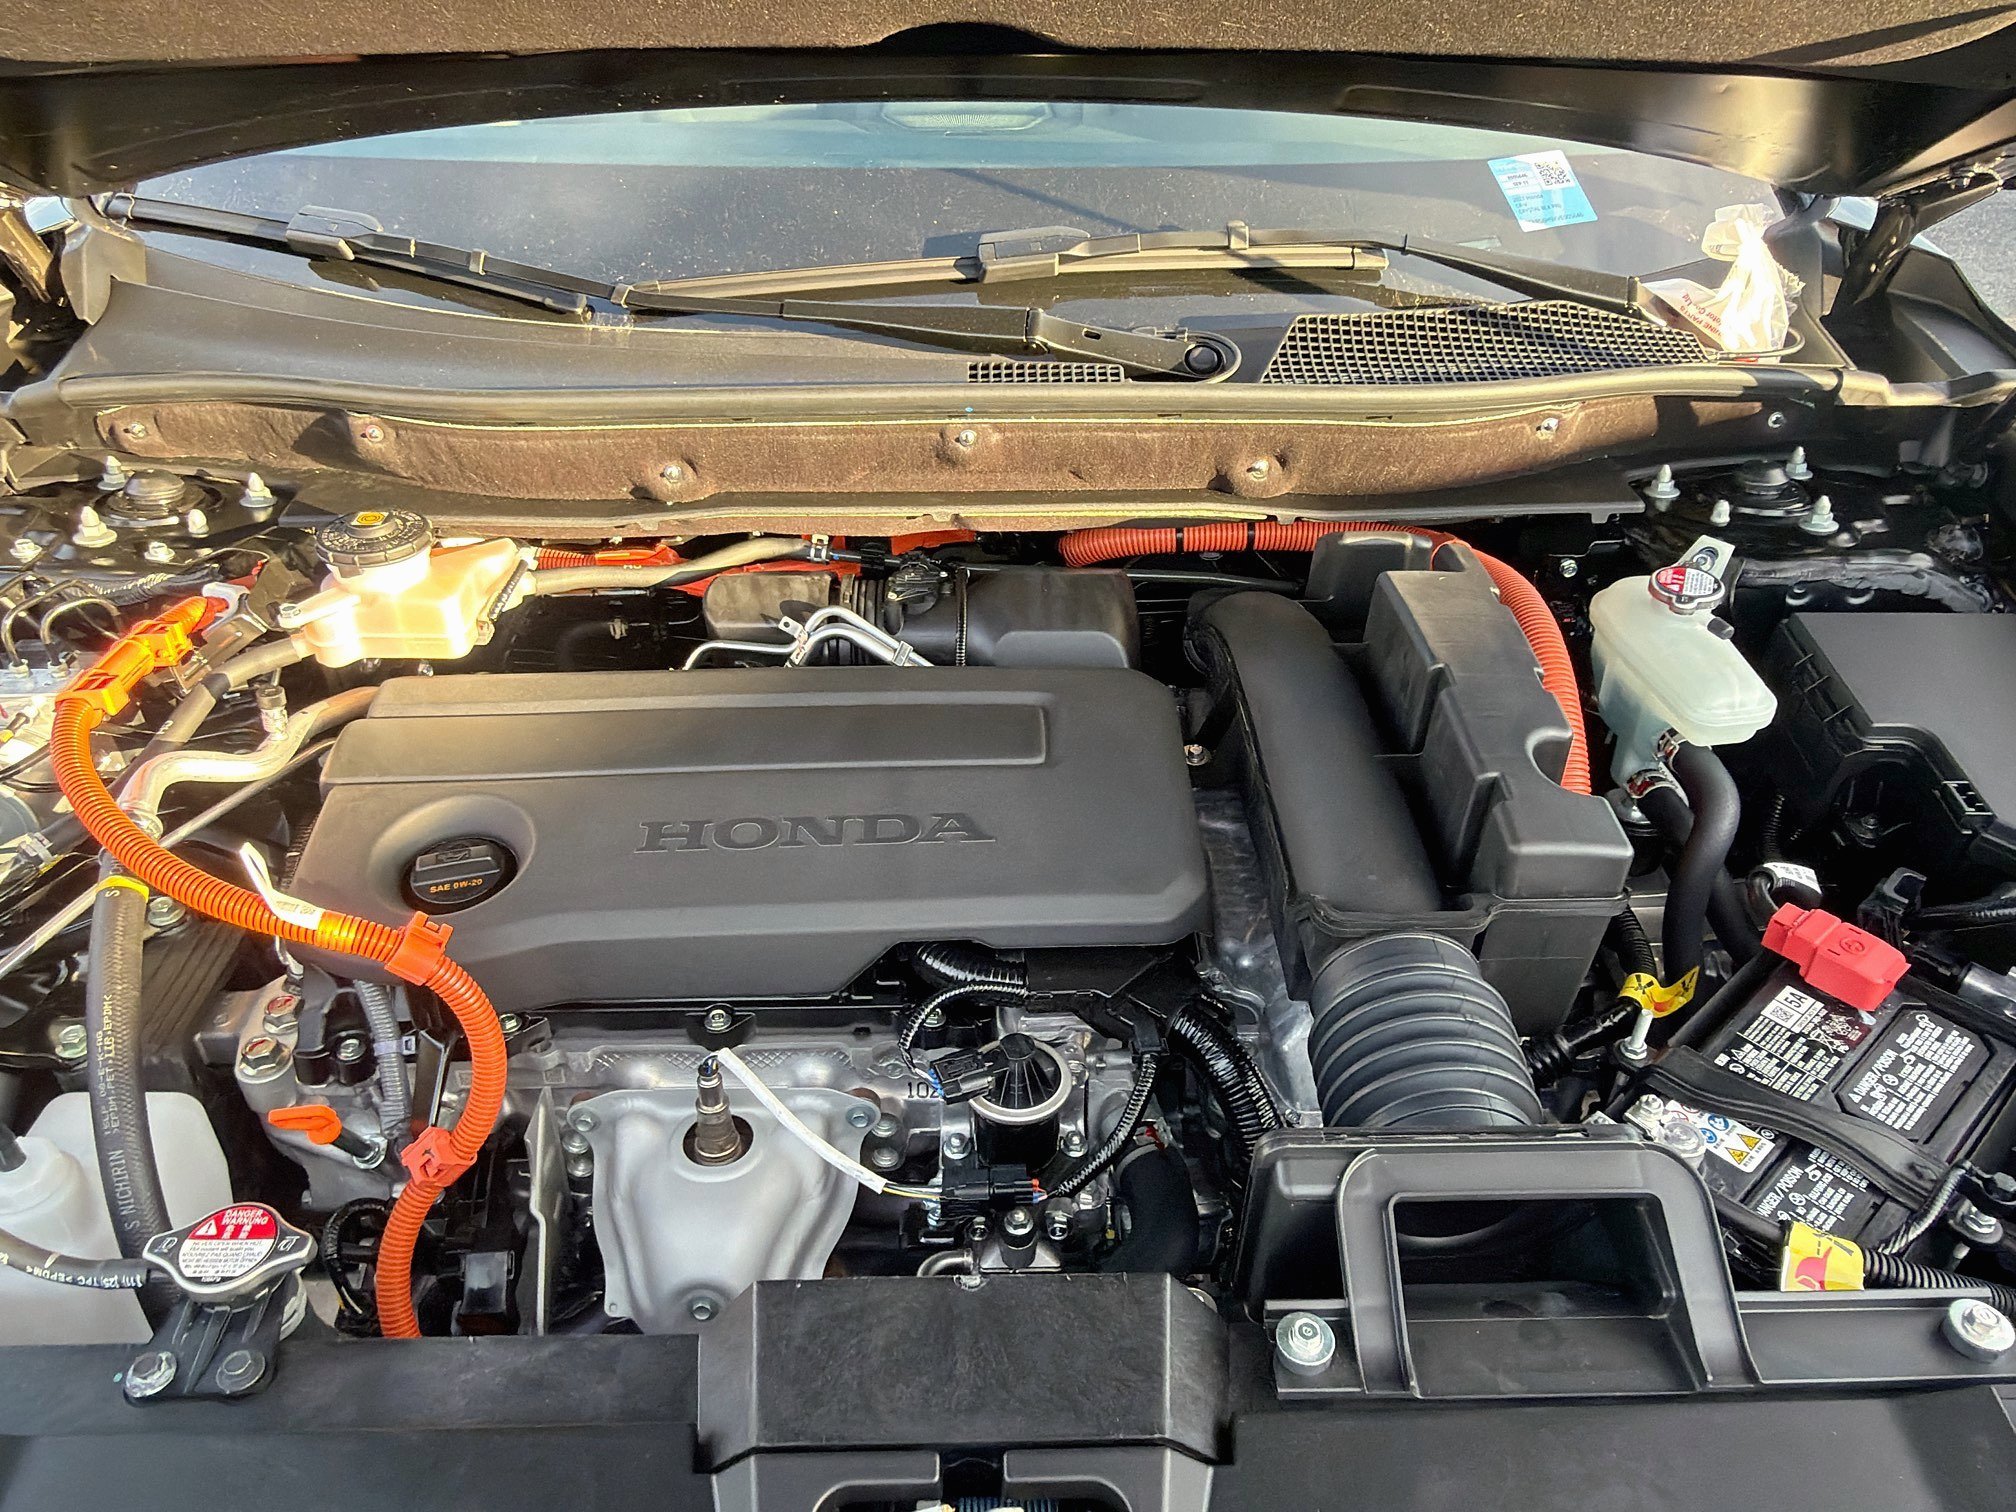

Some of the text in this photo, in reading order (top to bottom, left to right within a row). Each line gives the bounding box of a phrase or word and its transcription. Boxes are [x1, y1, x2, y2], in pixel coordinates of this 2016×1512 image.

[634, 812, 996, 853] HONDA
[429, 878, 483, 894] SAE 0W-20
[1784, 991, 1808, 1009] 5A
[107, 1149, 137, 1216] NICHIRIN
[224, 1209, 264, 1218] DANGER
